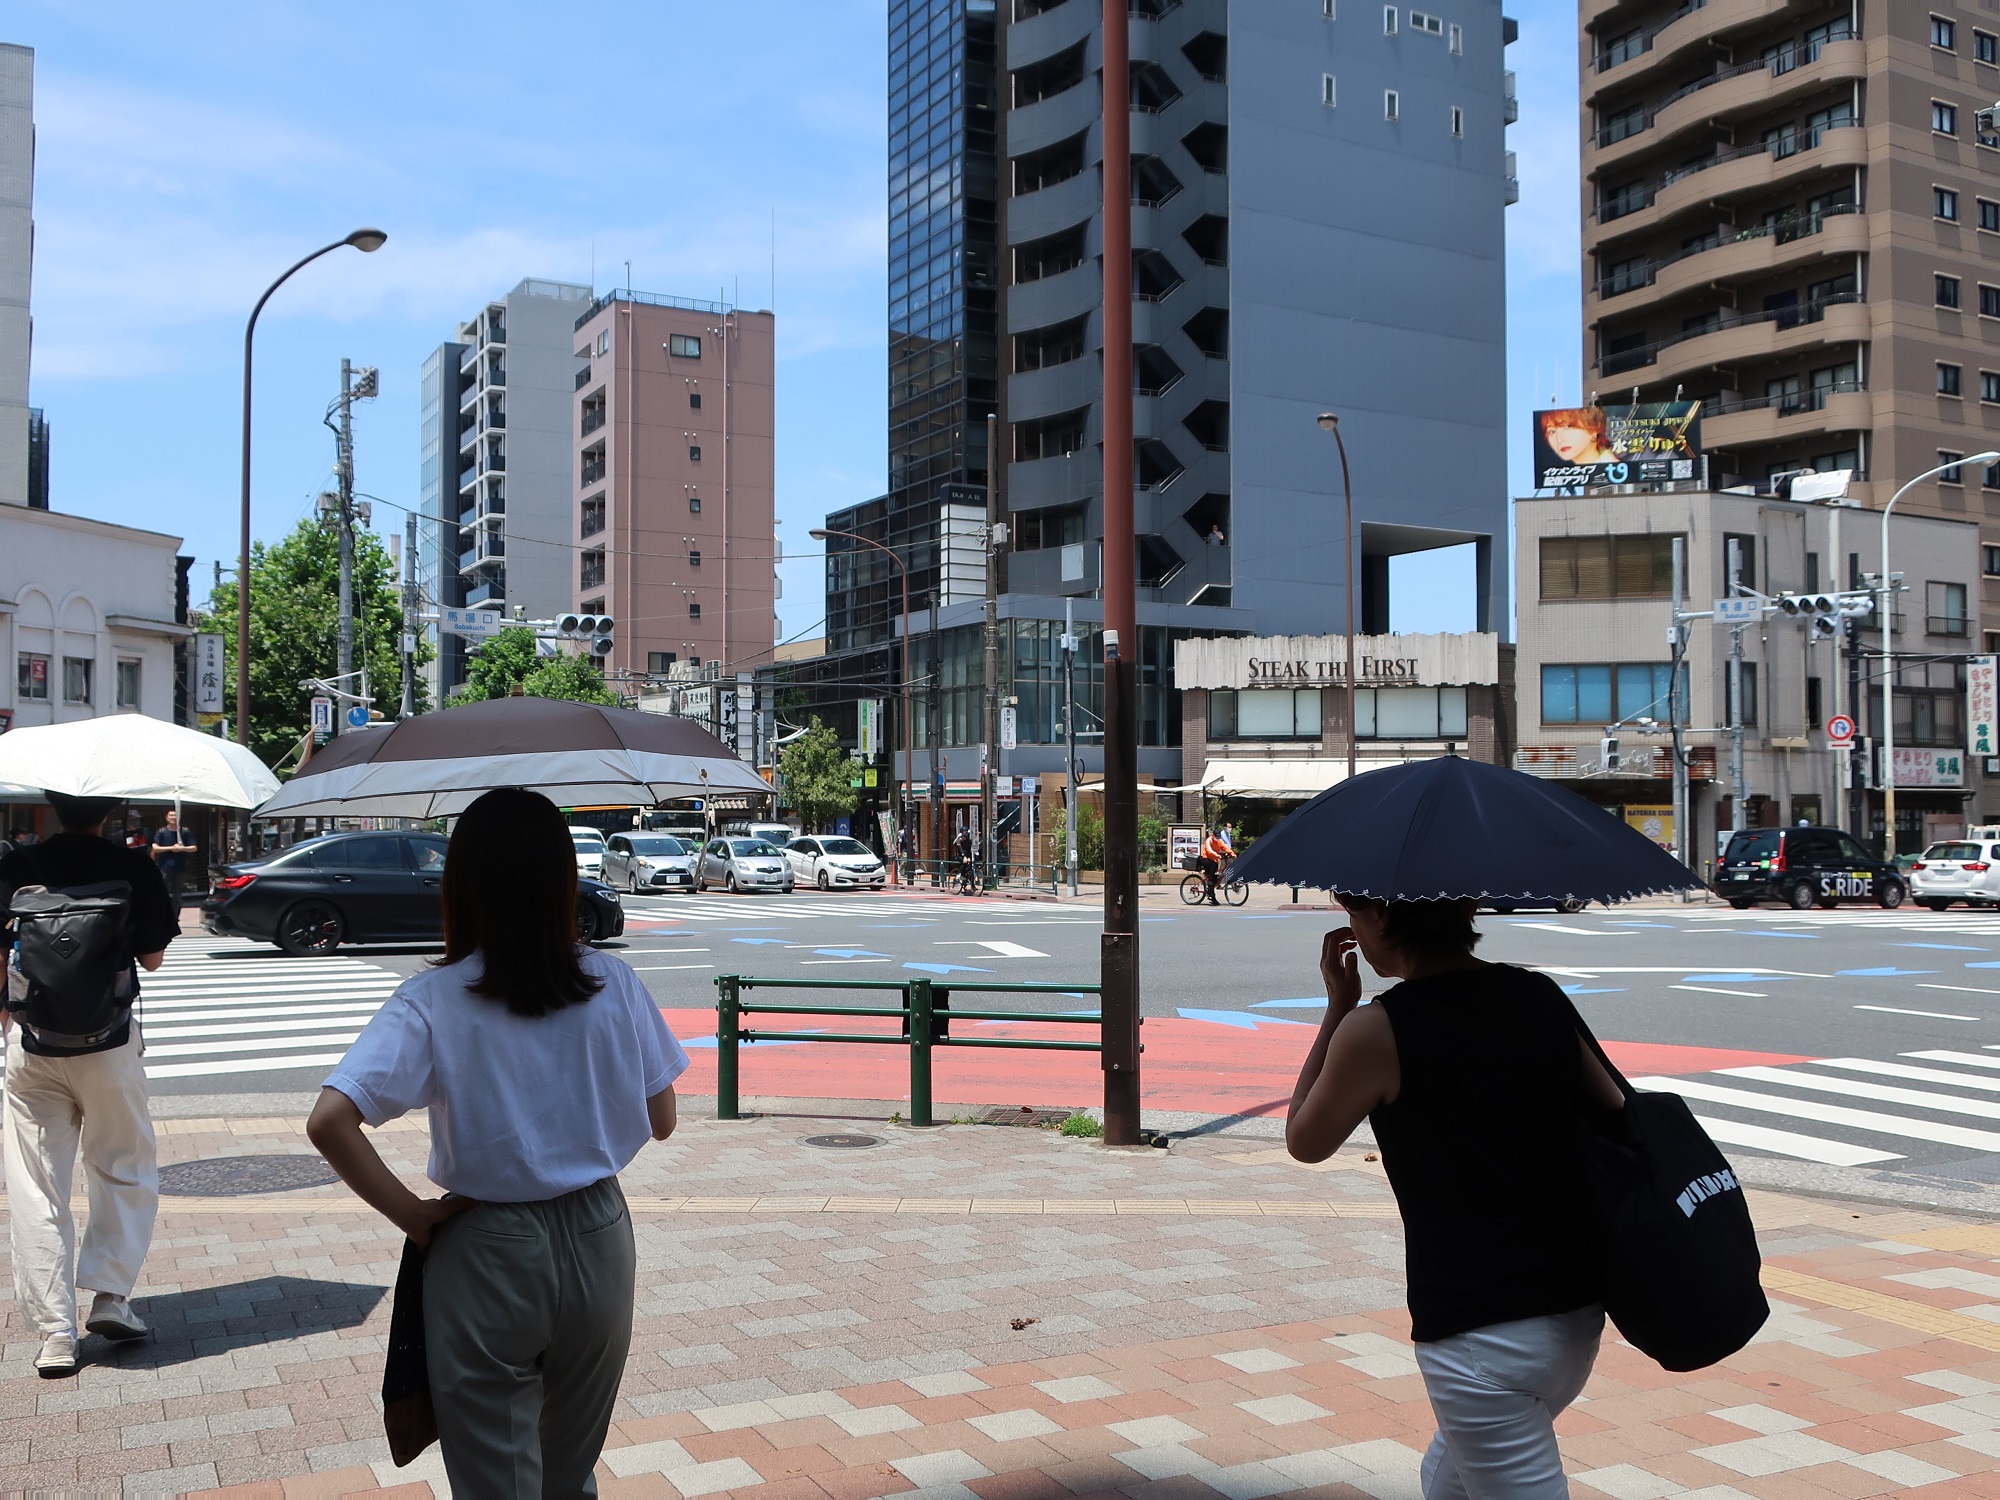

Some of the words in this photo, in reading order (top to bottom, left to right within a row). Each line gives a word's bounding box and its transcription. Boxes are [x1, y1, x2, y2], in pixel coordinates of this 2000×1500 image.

[1543, 465, 1597, 476] イケメンライブ
[1543, 475, 1589, 486] 配信アプリ
[447, 611, 492, 623] 馬場口
[1248, 657, 1309, 678] STEAK
[1361, 655, 1418, 677] FIRST
[1820, 878, 1873, 897] S.RIDE
